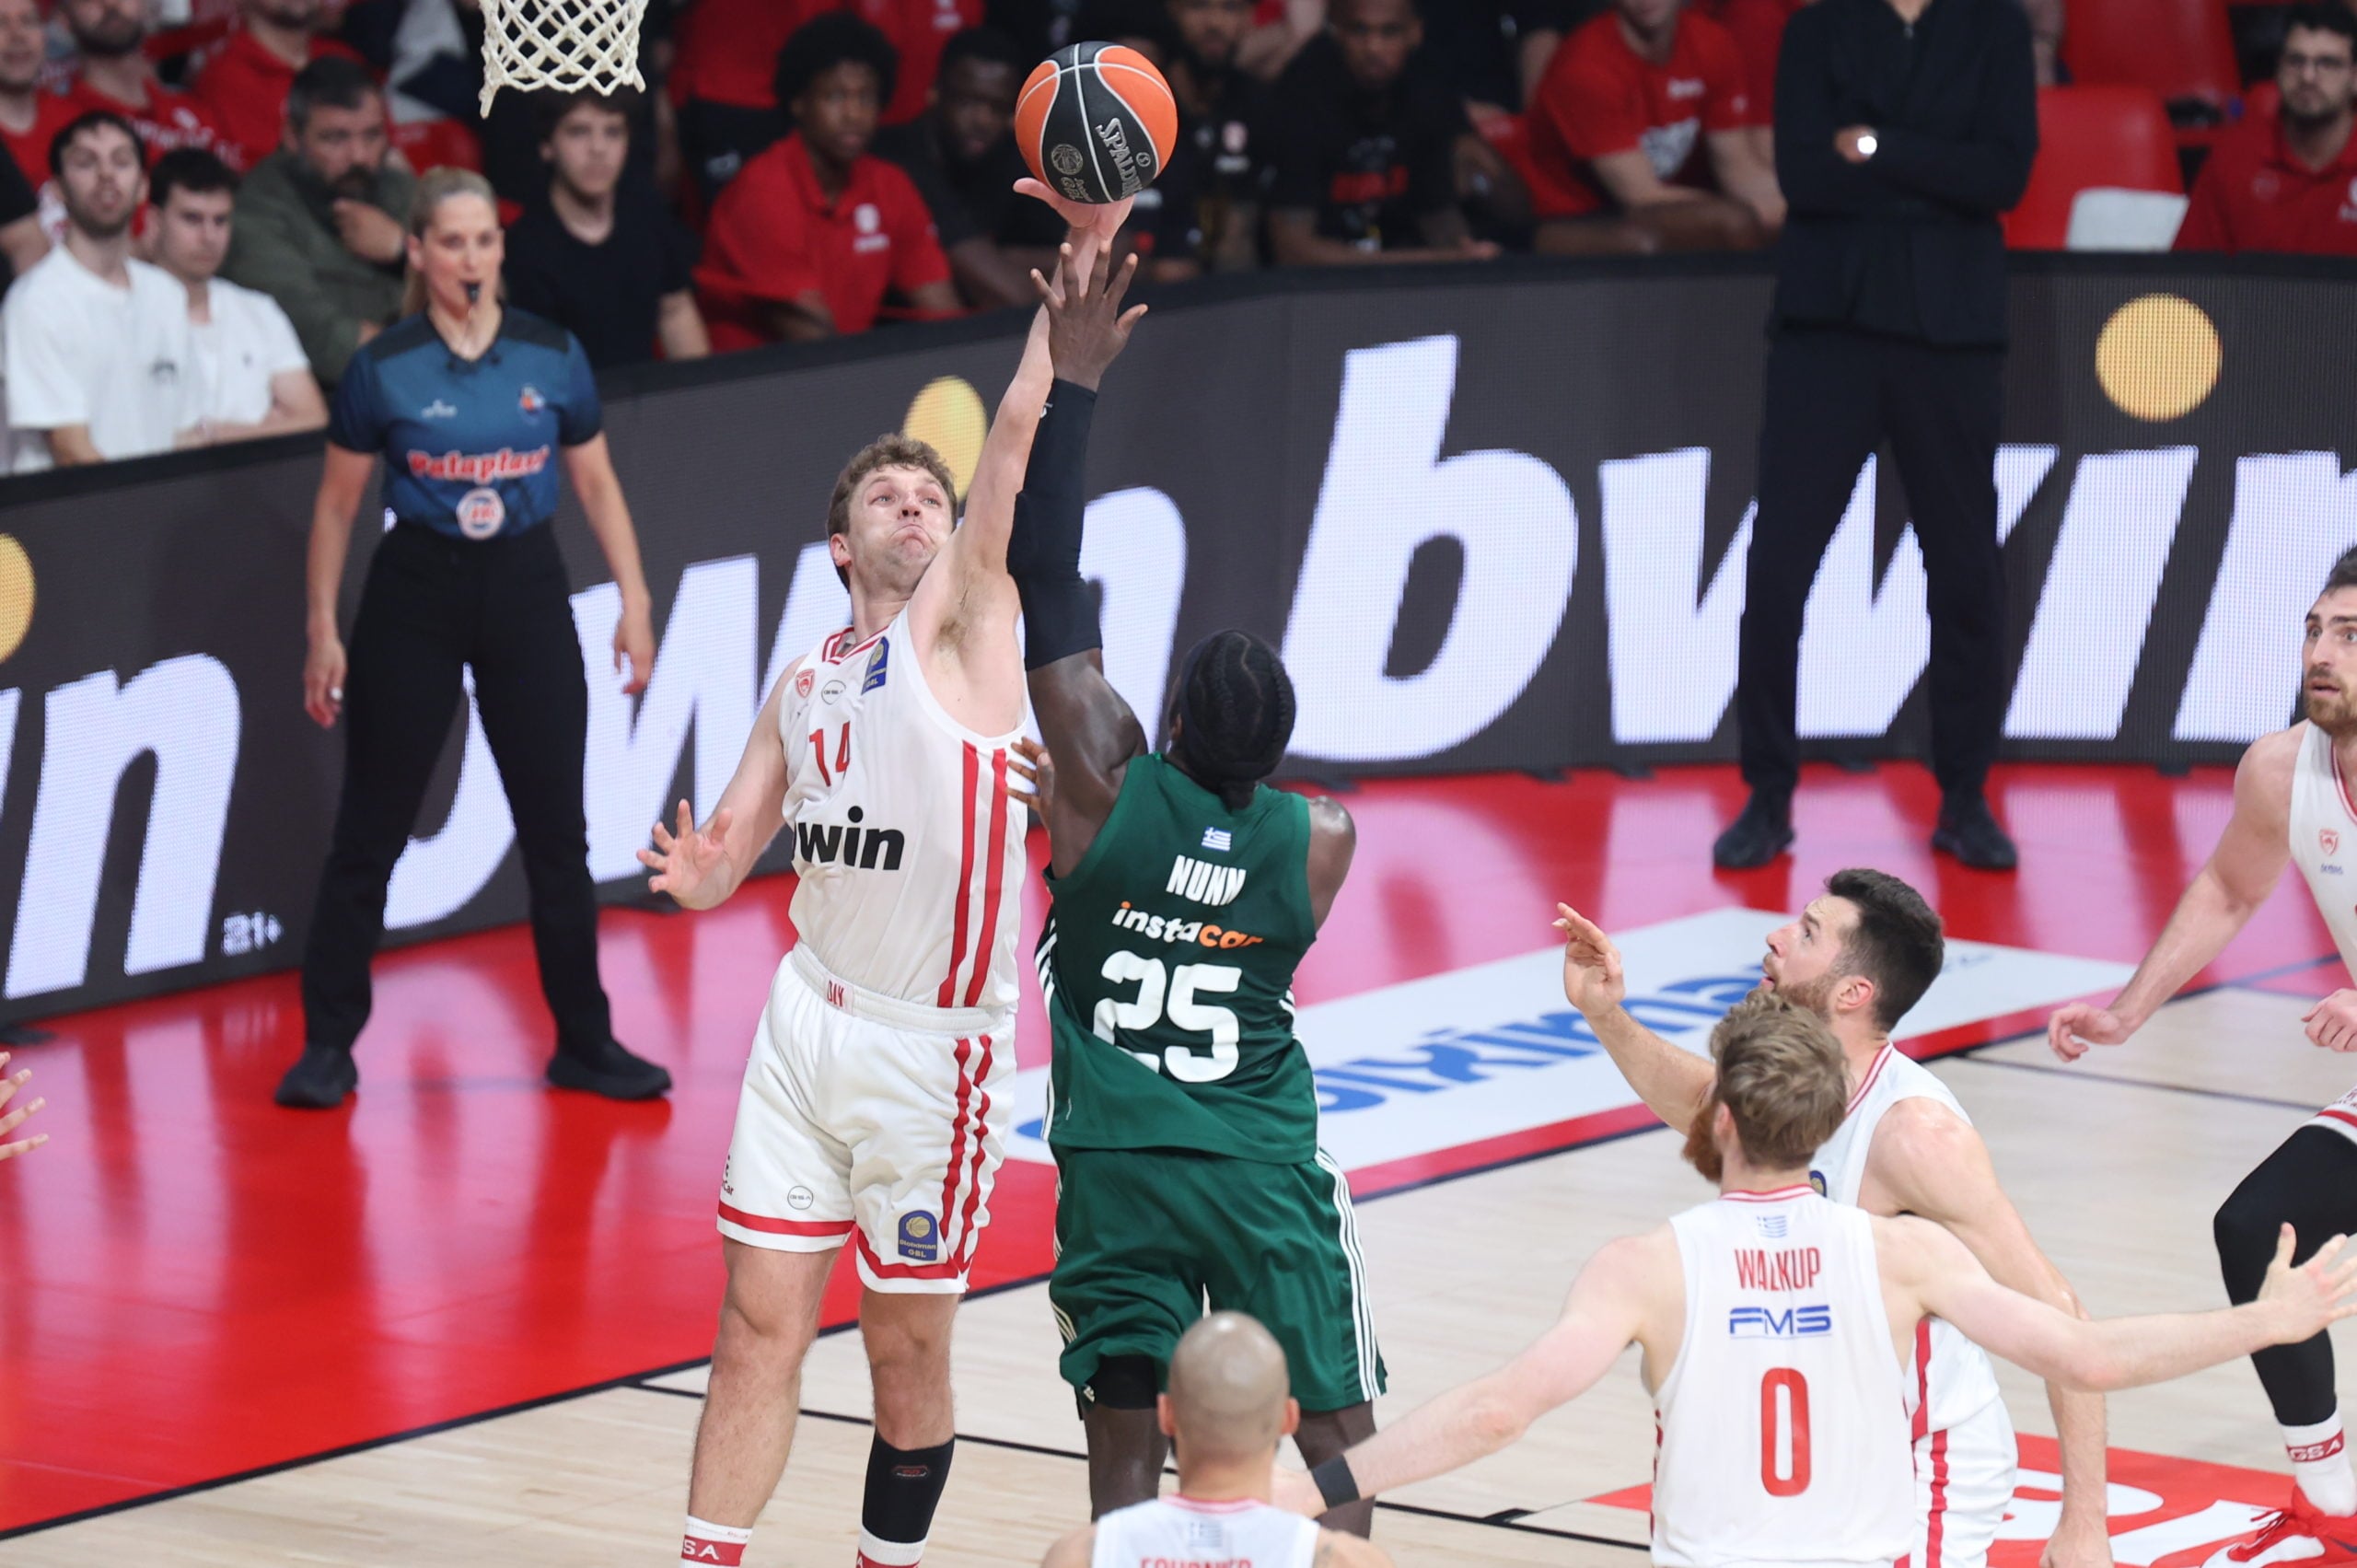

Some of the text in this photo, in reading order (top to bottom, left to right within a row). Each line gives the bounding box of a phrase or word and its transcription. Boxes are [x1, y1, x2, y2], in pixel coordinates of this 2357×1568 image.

[1095, 117, 1143, 200] SPALDIN
[808, 720, 851, 787] 14
[793, 806, 905, 871] win
[1166, 854, 1246, 906] NUNN
[1112, 900, 1264, 949] instacar
[1093, 950, 1242, 1083] 25
[1734, 1247, 1821, 1291] WALKUP
[1729, 1305, 1831, 1335] FMS
[1760, 1367, 1812, 1497] 0
